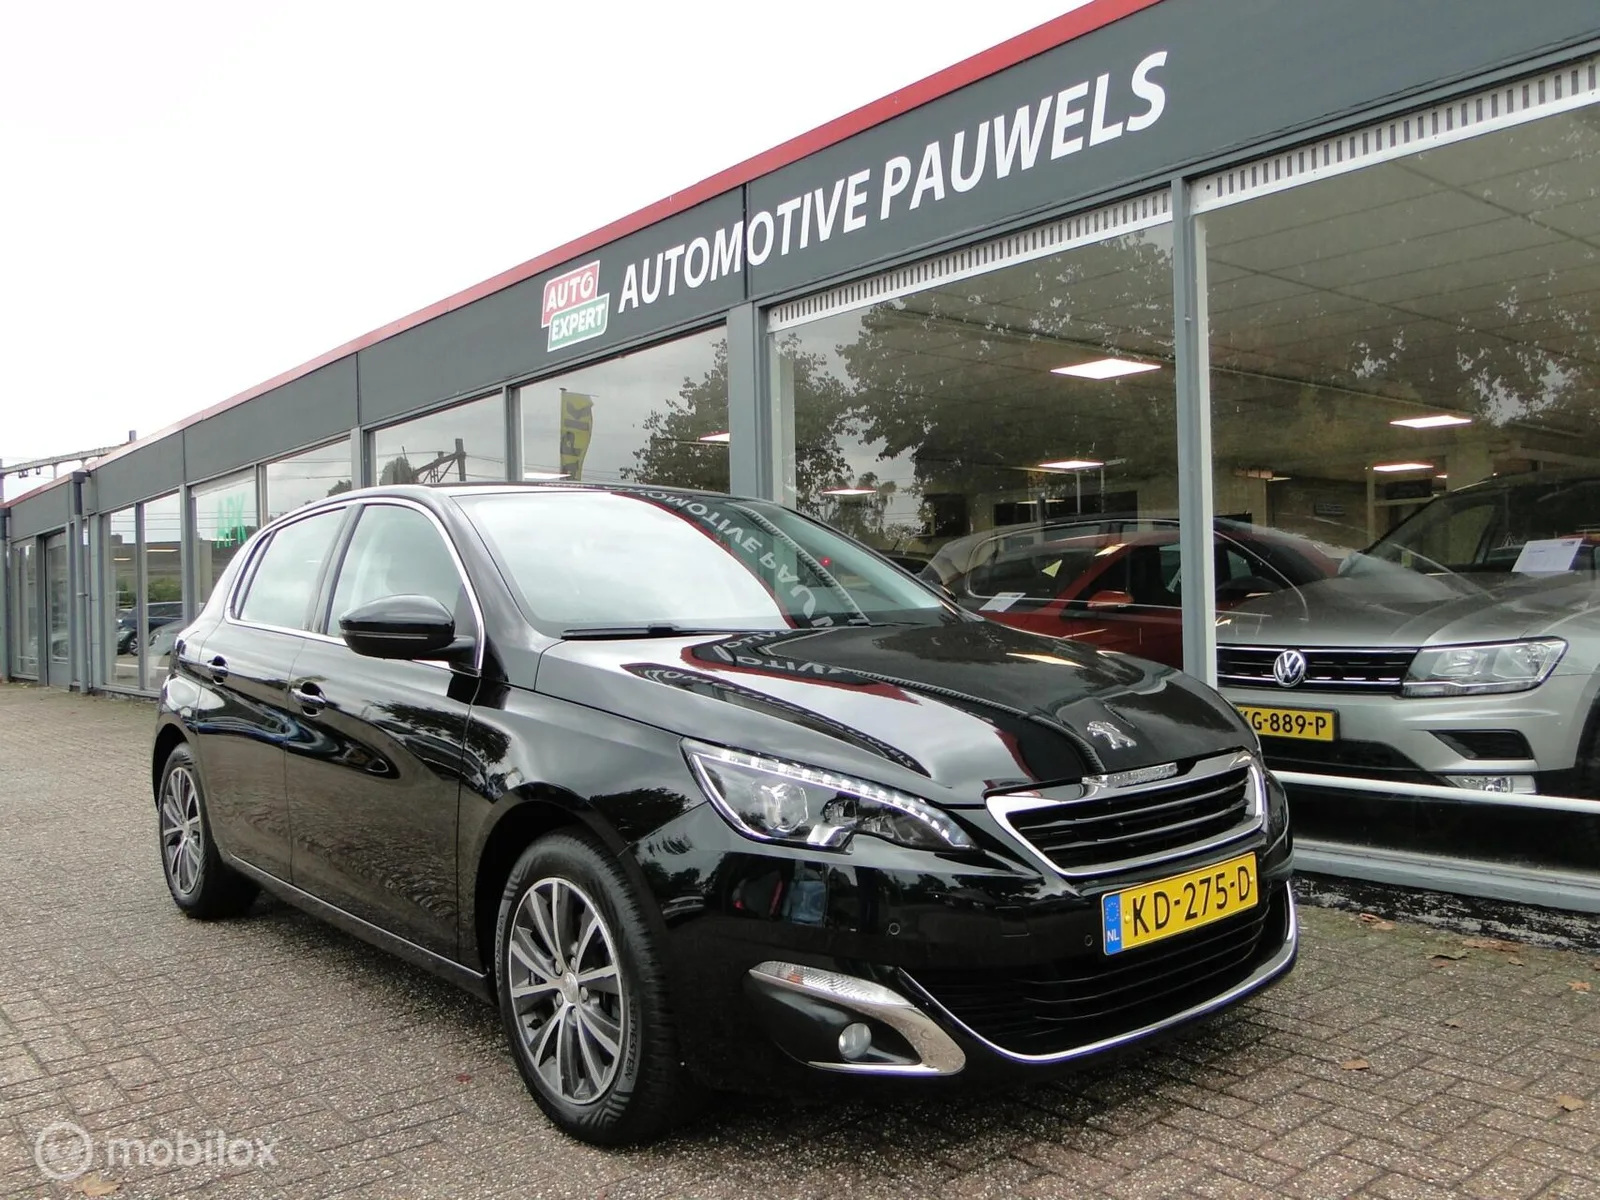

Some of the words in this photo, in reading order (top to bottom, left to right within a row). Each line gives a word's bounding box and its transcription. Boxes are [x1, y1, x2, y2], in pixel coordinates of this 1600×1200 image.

[618, 169, 871, 313] AUTOMOTIVE
[881, 51, 1168, 220] PAUWELS
[546, 271, 594, 312] AUTO
[552, 303, 606, 341] EXPERT
[1132, 866, 1250, 937] KD-275-D
[1106, 928, 1120, 942] NL
